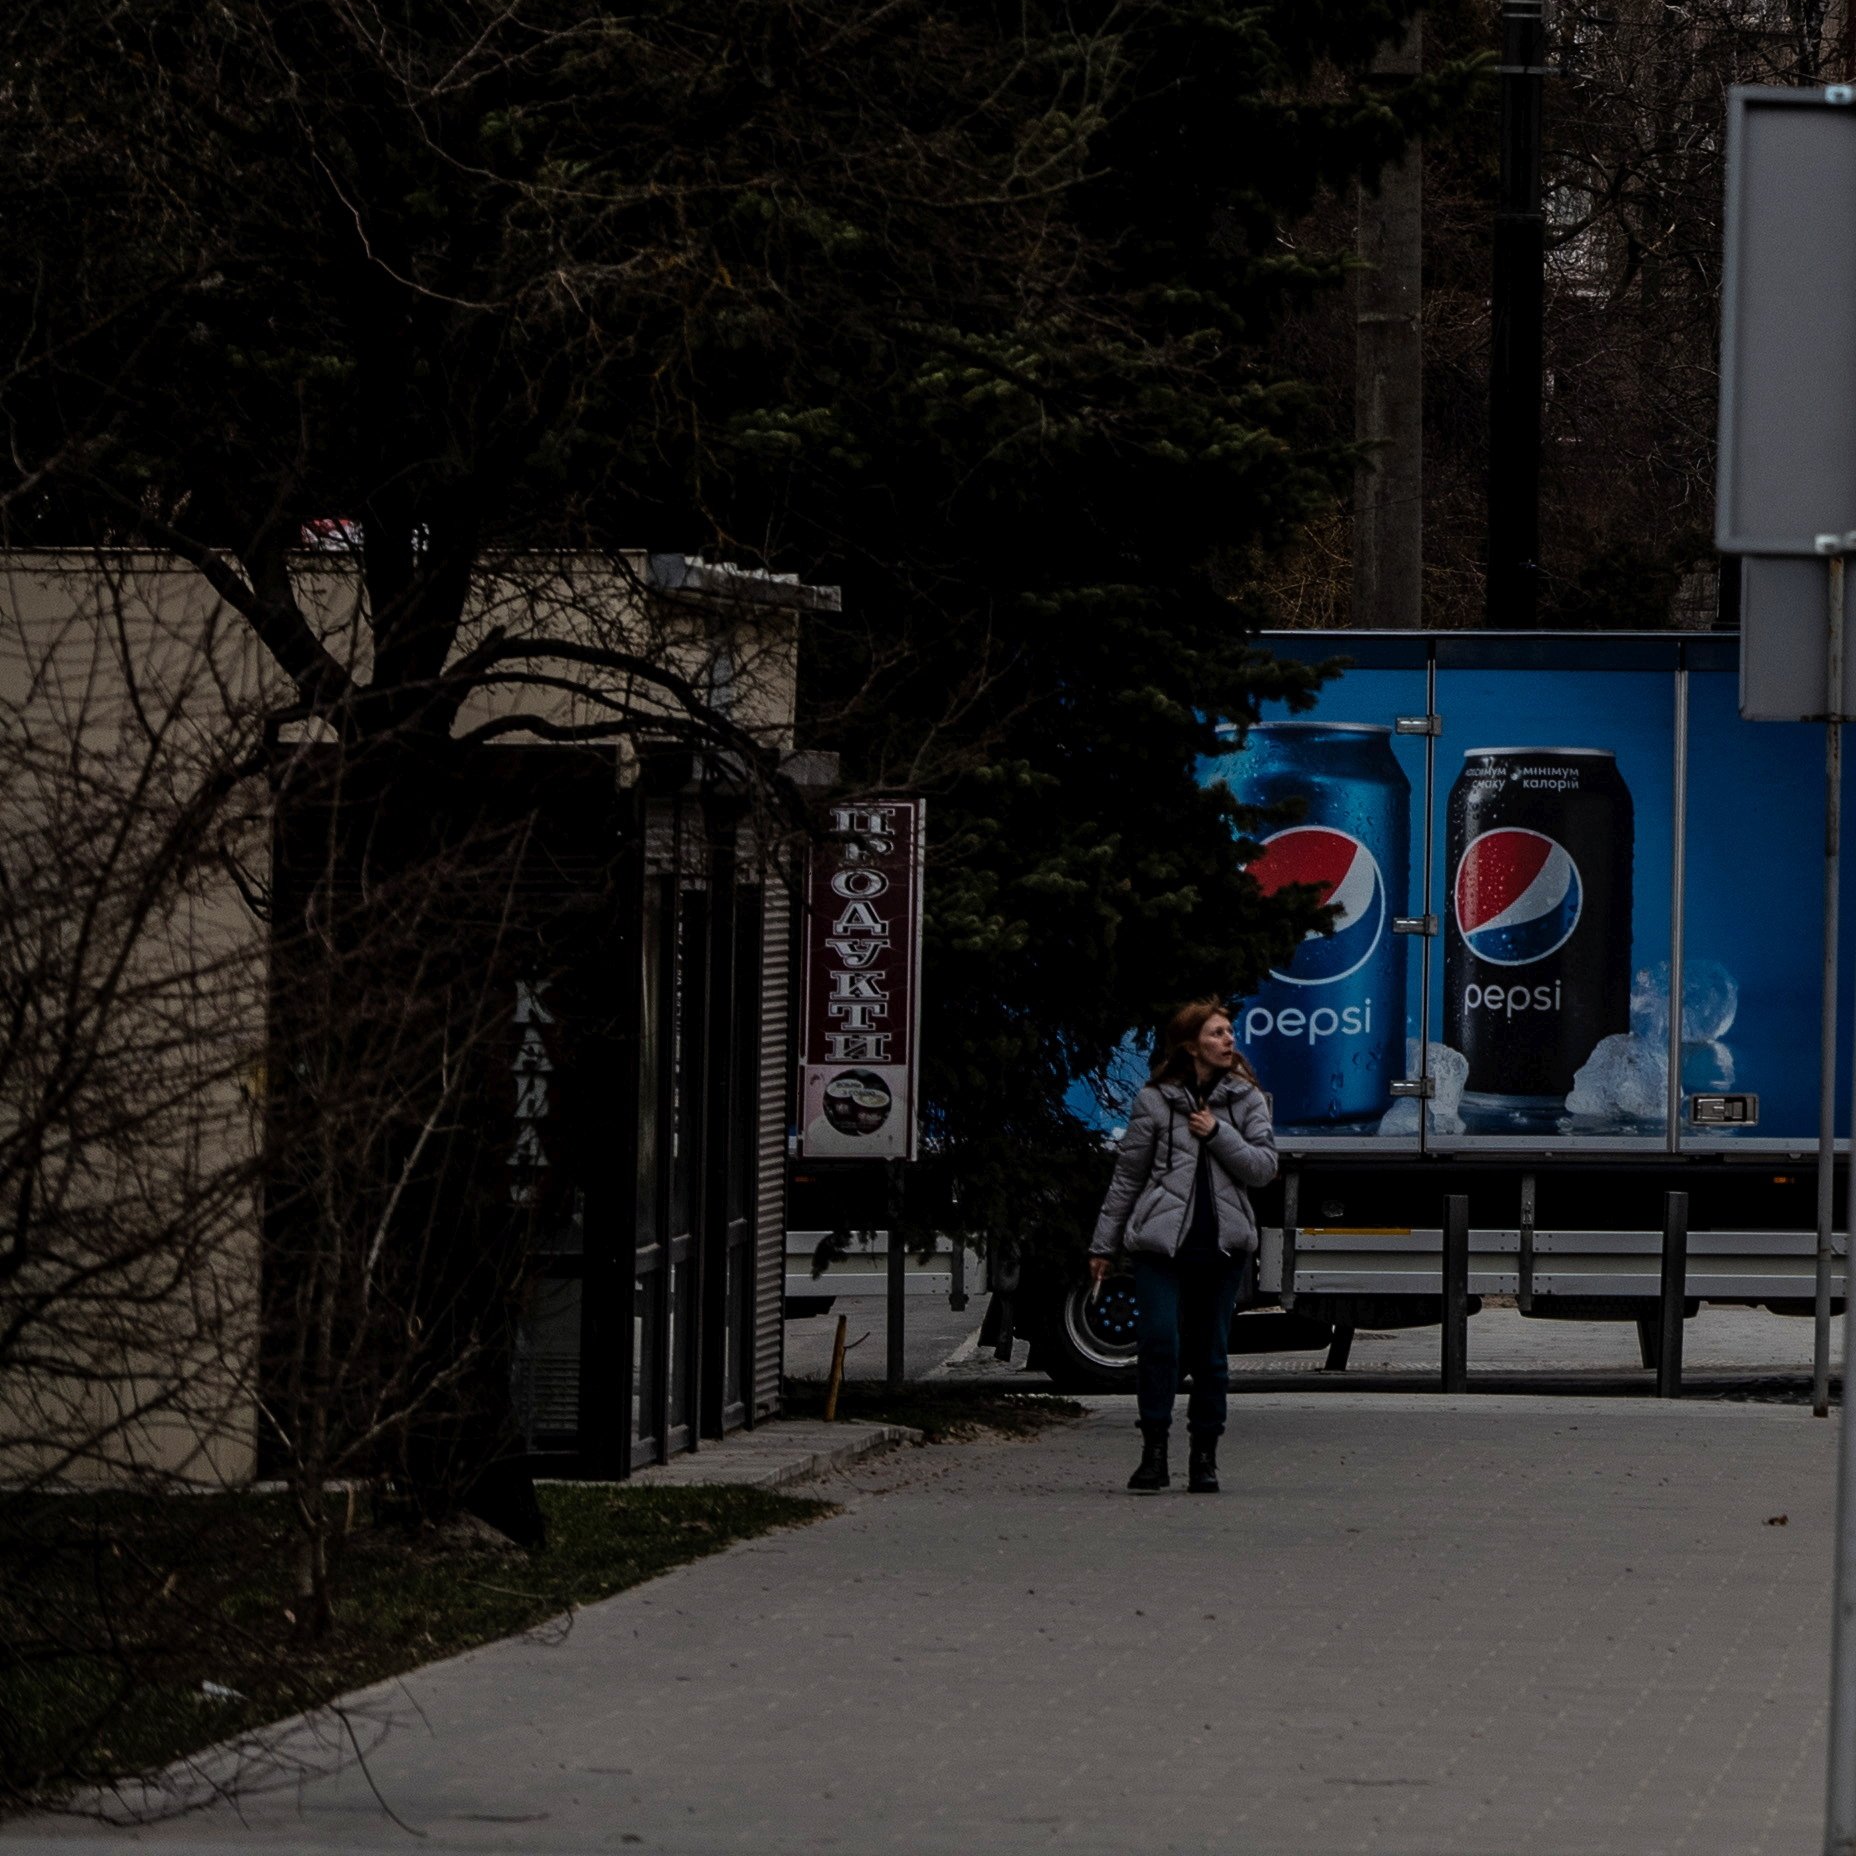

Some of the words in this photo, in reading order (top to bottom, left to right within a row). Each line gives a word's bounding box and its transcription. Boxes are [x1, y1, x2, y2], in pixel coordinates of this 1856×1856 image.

[1523, 767, 1579, 779] мінімум
[1523, 777, 1579, 792] калорій
[1464, 979, 1562, 1019] pepsi
[1244, 997, 1372, 1046] pepsi
